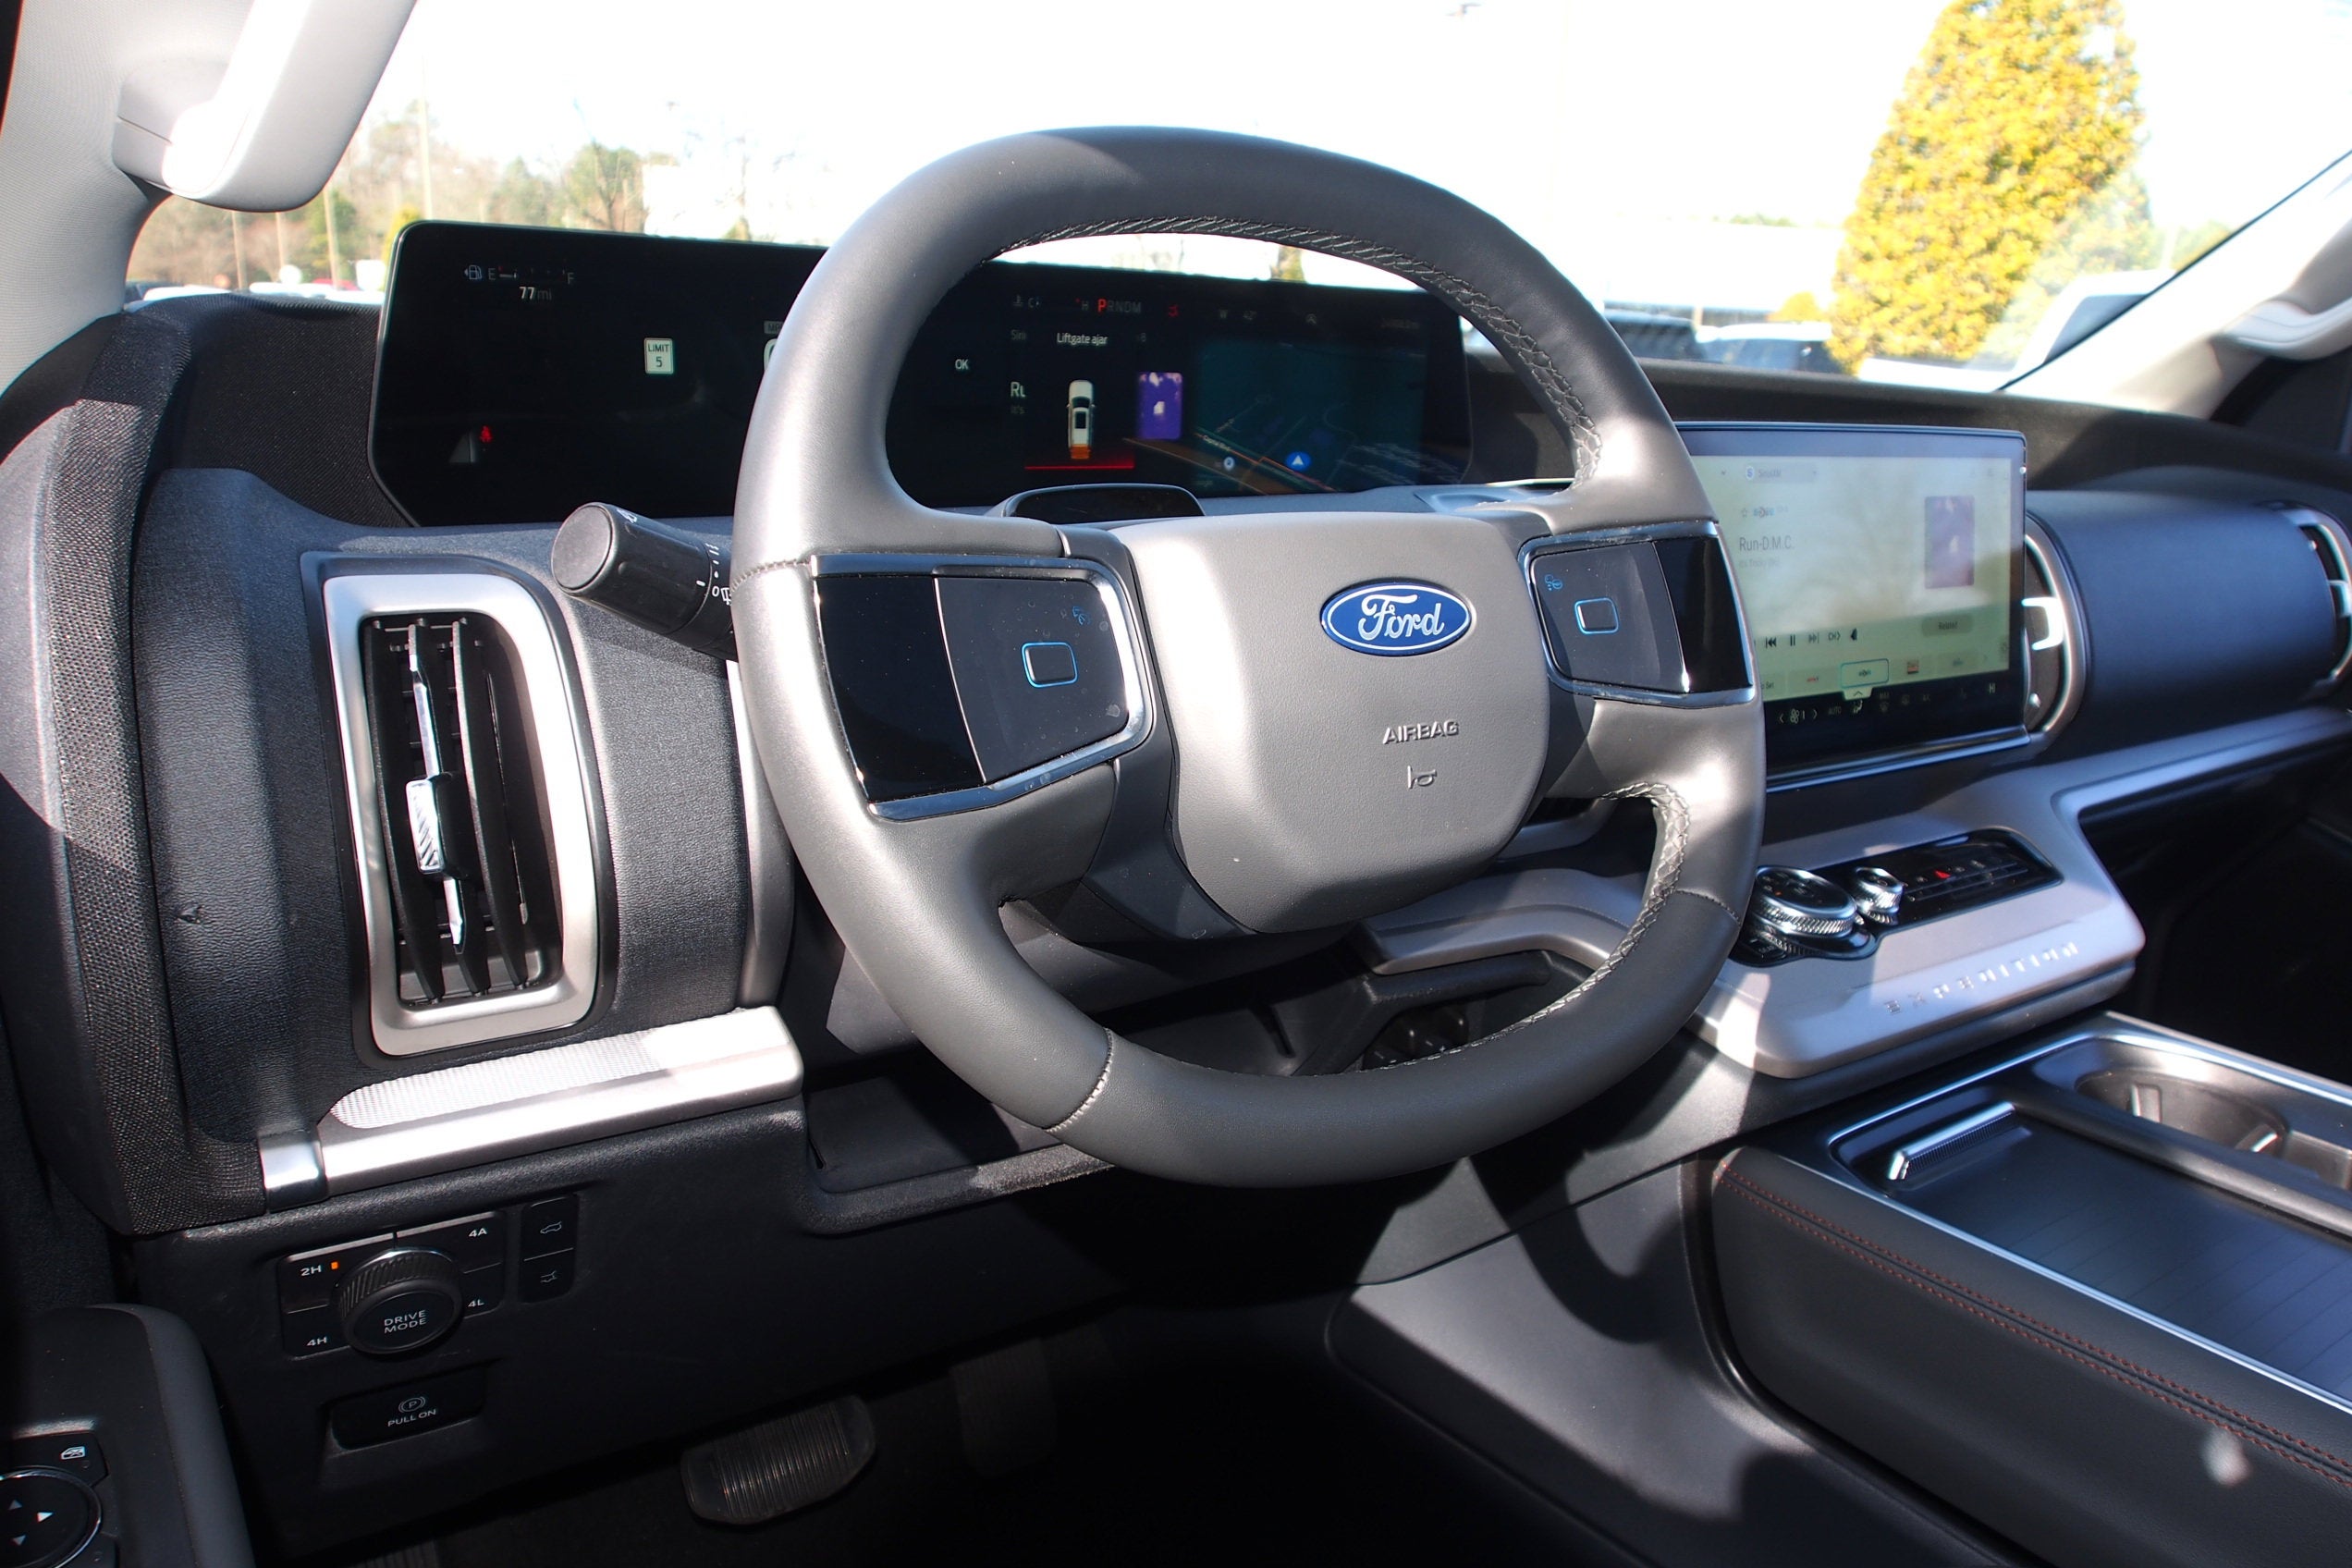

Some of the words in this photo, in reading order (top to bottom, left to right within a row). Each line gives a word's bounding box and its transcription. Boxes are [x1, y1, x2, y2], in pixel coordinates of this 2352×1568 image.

[1056, 332, 1091, 346] Liftgate
[1091, 333, 1109, 346] ajar
[647, 344, 669, 353] LIMIT
[655, 356, 663, 368] 5
[954, 359, 969, 370] OK
[1739, 535, 1795, 551] Run-D.M.C.
[1358, 594, 1445, 641] Ford
[1382, 718, 1460, 745] AIRBAG
[468, 1227, 488, 1238] 4A
[300, 1265, 322, 1277] 2H
[468, 1298, 485, 1309] 4L
[384, 1309, 427, 1326] DRIVE
[384, 1317, 427, 1334] MODE
[306, 1336, 328, 1348] 4H
[387, 1415, 416, 1427] PULL
[418, 1409, 436, 1419] ON
